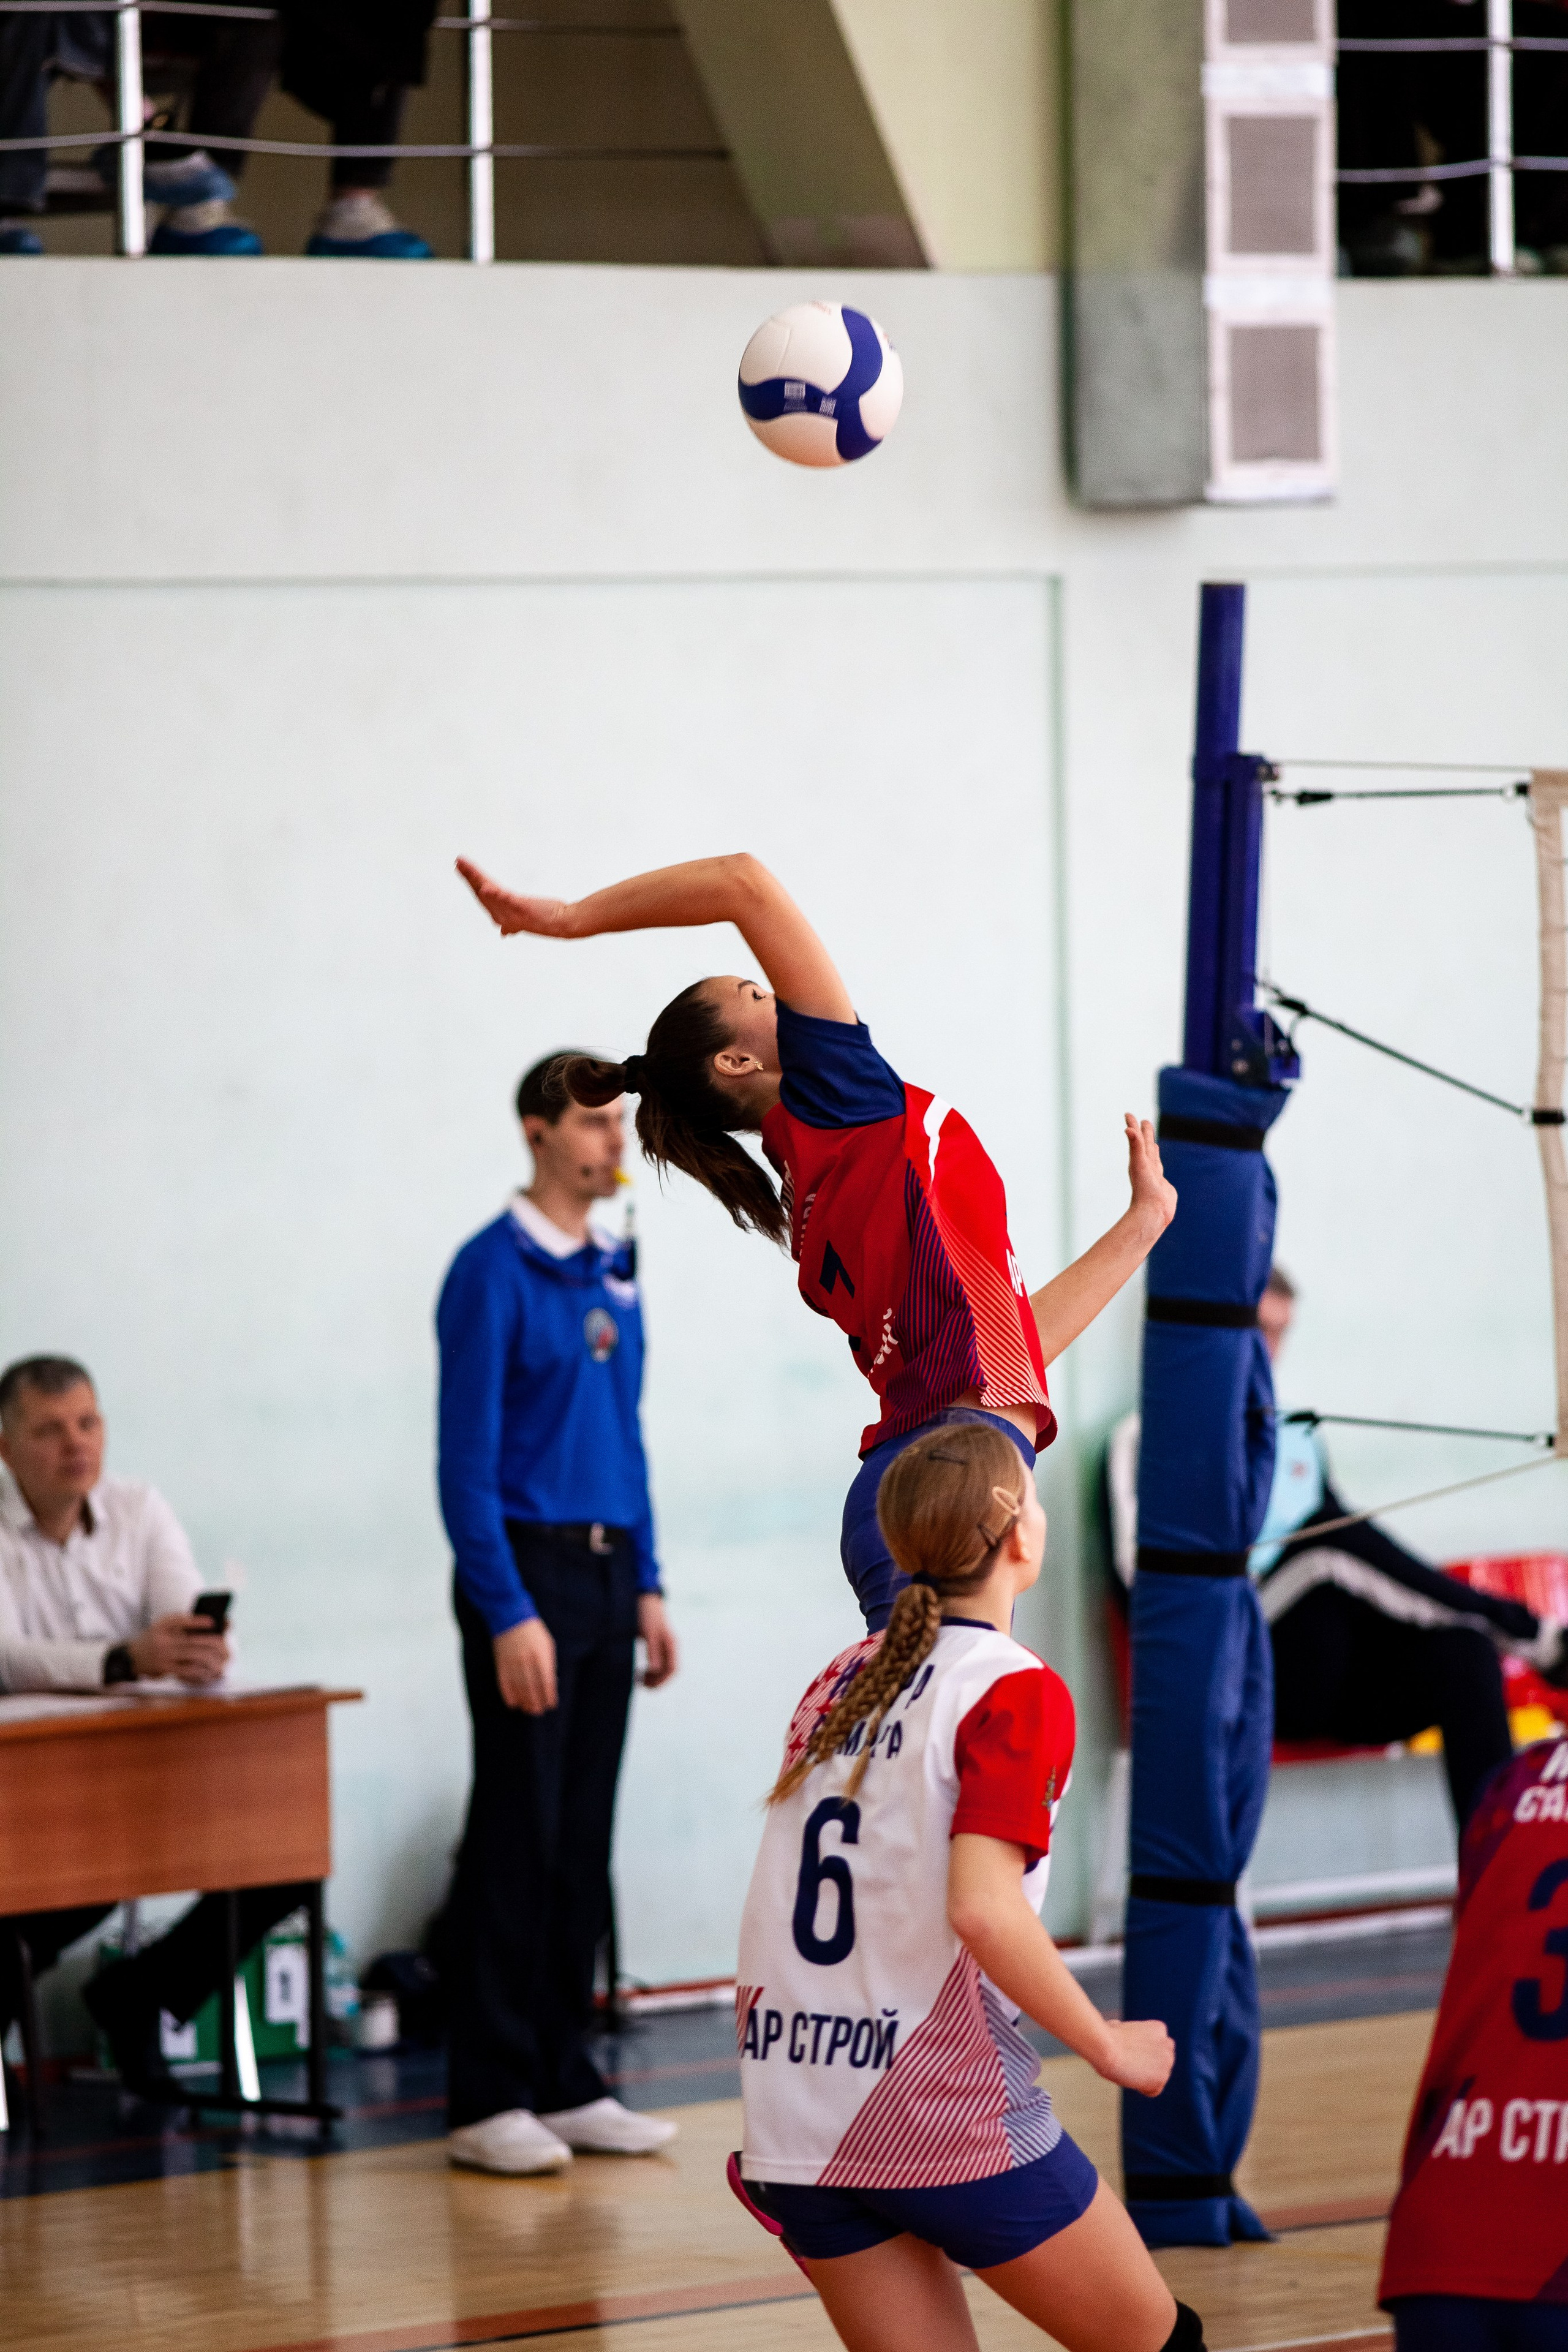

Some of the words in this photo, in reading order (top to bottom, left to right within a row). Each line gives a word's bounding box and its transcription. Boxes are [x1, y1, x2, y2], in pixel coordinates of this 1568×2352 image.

[793, 1796, 861, 1966] 6
[1510, 1858, 1568, 2042] 3
[788, 2007, 899, 2070] СТРОЙ
[1431, 2097, 1494, 2159] АР
